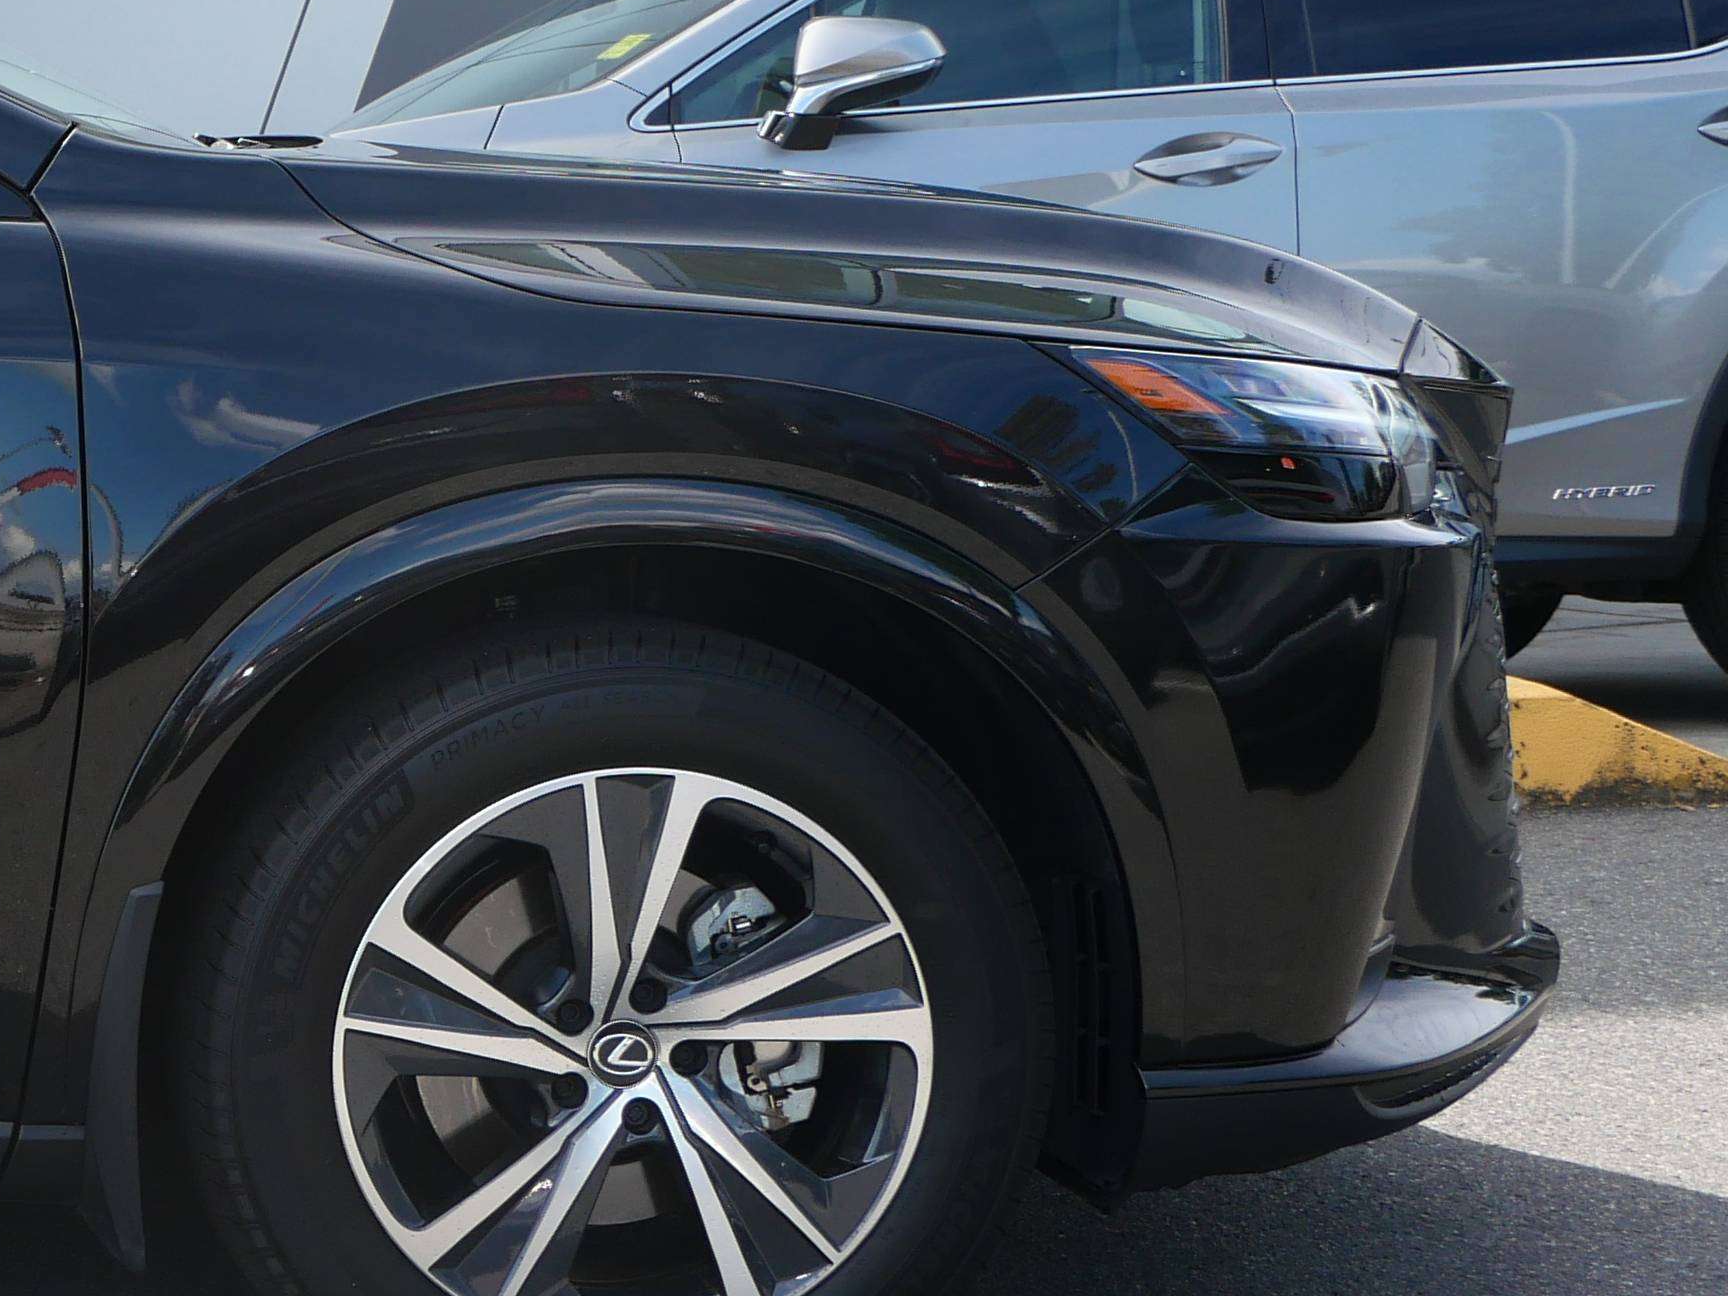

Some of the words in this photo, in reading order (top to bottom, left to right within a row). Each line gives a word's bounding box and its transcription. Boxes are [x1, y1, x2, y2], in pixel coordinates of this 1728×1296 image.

[1552, 484, 1656, 500] HYBRID
[430, 704, 545, 771] PRIMACY
[273, 784, 405, 979] MICHELIN
